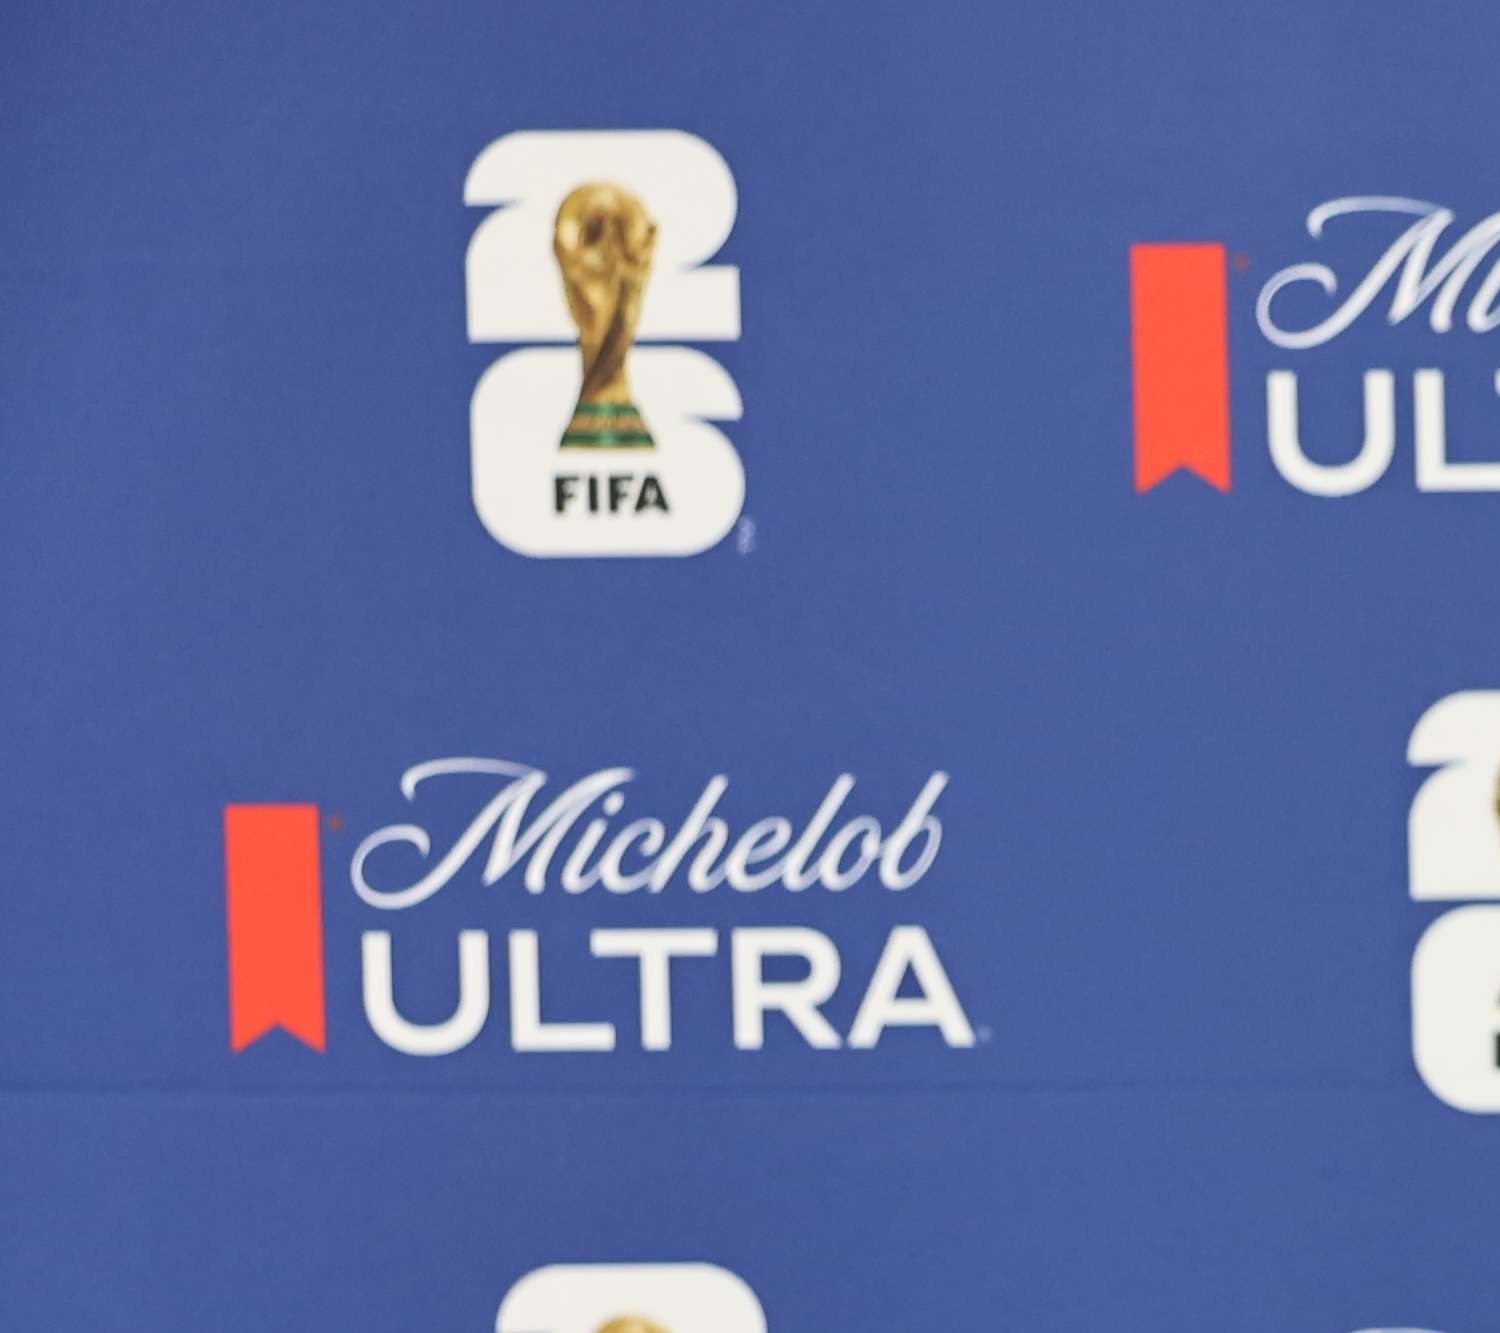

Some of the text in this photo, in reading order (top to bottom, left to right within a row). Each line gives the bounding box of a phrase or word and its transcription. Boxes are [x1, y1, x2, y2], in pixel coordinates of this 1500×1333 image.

[555, 476, 668, 512] FIFA
[352, 759, 946, 908] Michelob
[362, 927, 974, 1054] ULTRA
